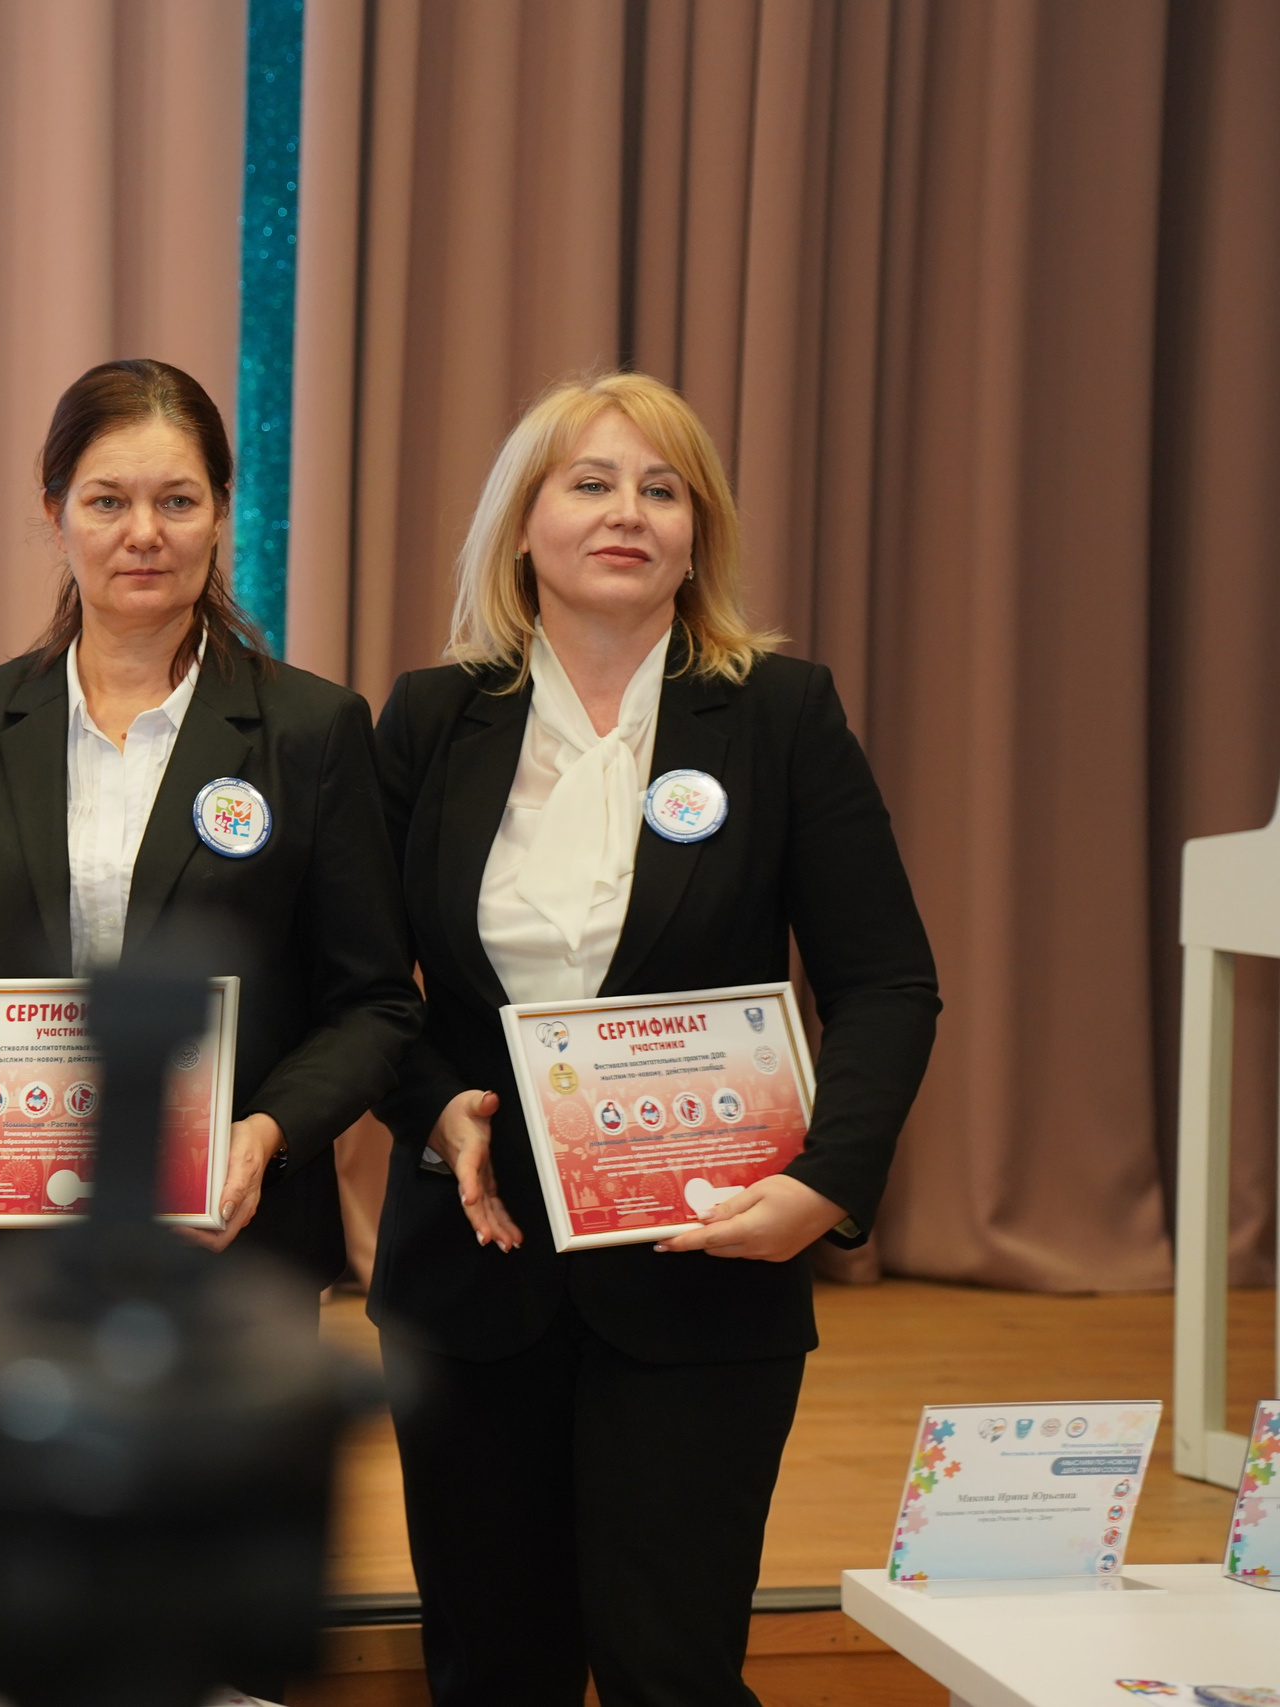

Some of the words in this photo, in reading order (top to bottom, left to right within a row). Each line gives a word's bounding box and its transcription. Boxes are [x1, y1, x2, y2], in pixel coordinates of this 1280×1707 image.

[6, 1001, 89, 1023] СЕРТИФИ
[597, 1014, 707, 1040] СЕРТИФИКАТ
[629, 1040, 686, 1056] участника
